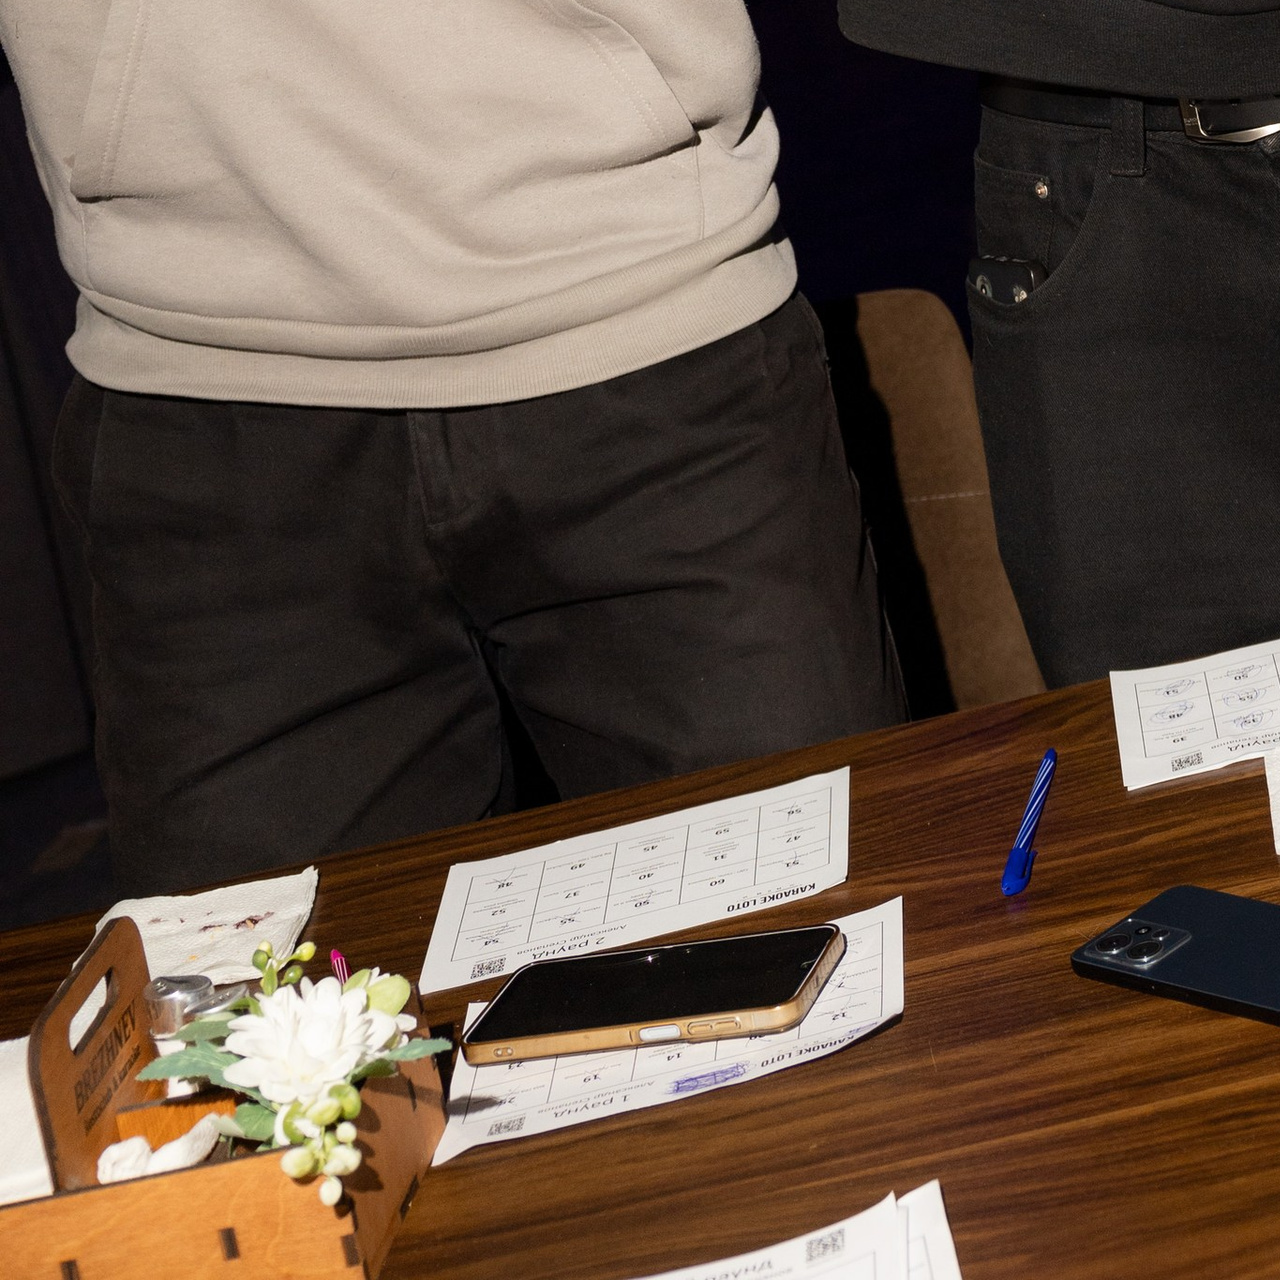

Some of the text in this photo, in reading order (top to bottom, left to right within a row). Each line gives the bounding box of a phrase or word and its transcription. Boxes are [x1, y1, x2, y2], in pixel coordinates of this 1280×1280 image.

[1172, 736, 1187, 744] 39
[715, 827, 730, 835] 59
[786, 835, 801, 843] 47
[643, 844, 658, 852] 45
[570, 862, 586, 870] 49
[638, 872, 654, 880] 40
[709, 878, 725, 887] 60
[565, 891, 580, 899] 37
[759, 882, 816, 905] KARAOKE
[727, 899, 758, 913] LOTO
[491, 908, 506, 917] 52
[517, 924, 628, 955] Александр Степанов
[531, 937, 605, 960] 2 раунд
[796, 1035, 855, 1059] KARAOKE
[666, 1052, 682, 1061] 14
[760, 1053, 793, 1068] LOTO
[537, 1081, 656, 1114] Александр Степанов
[553, 1097, 614, 1118] раунд
